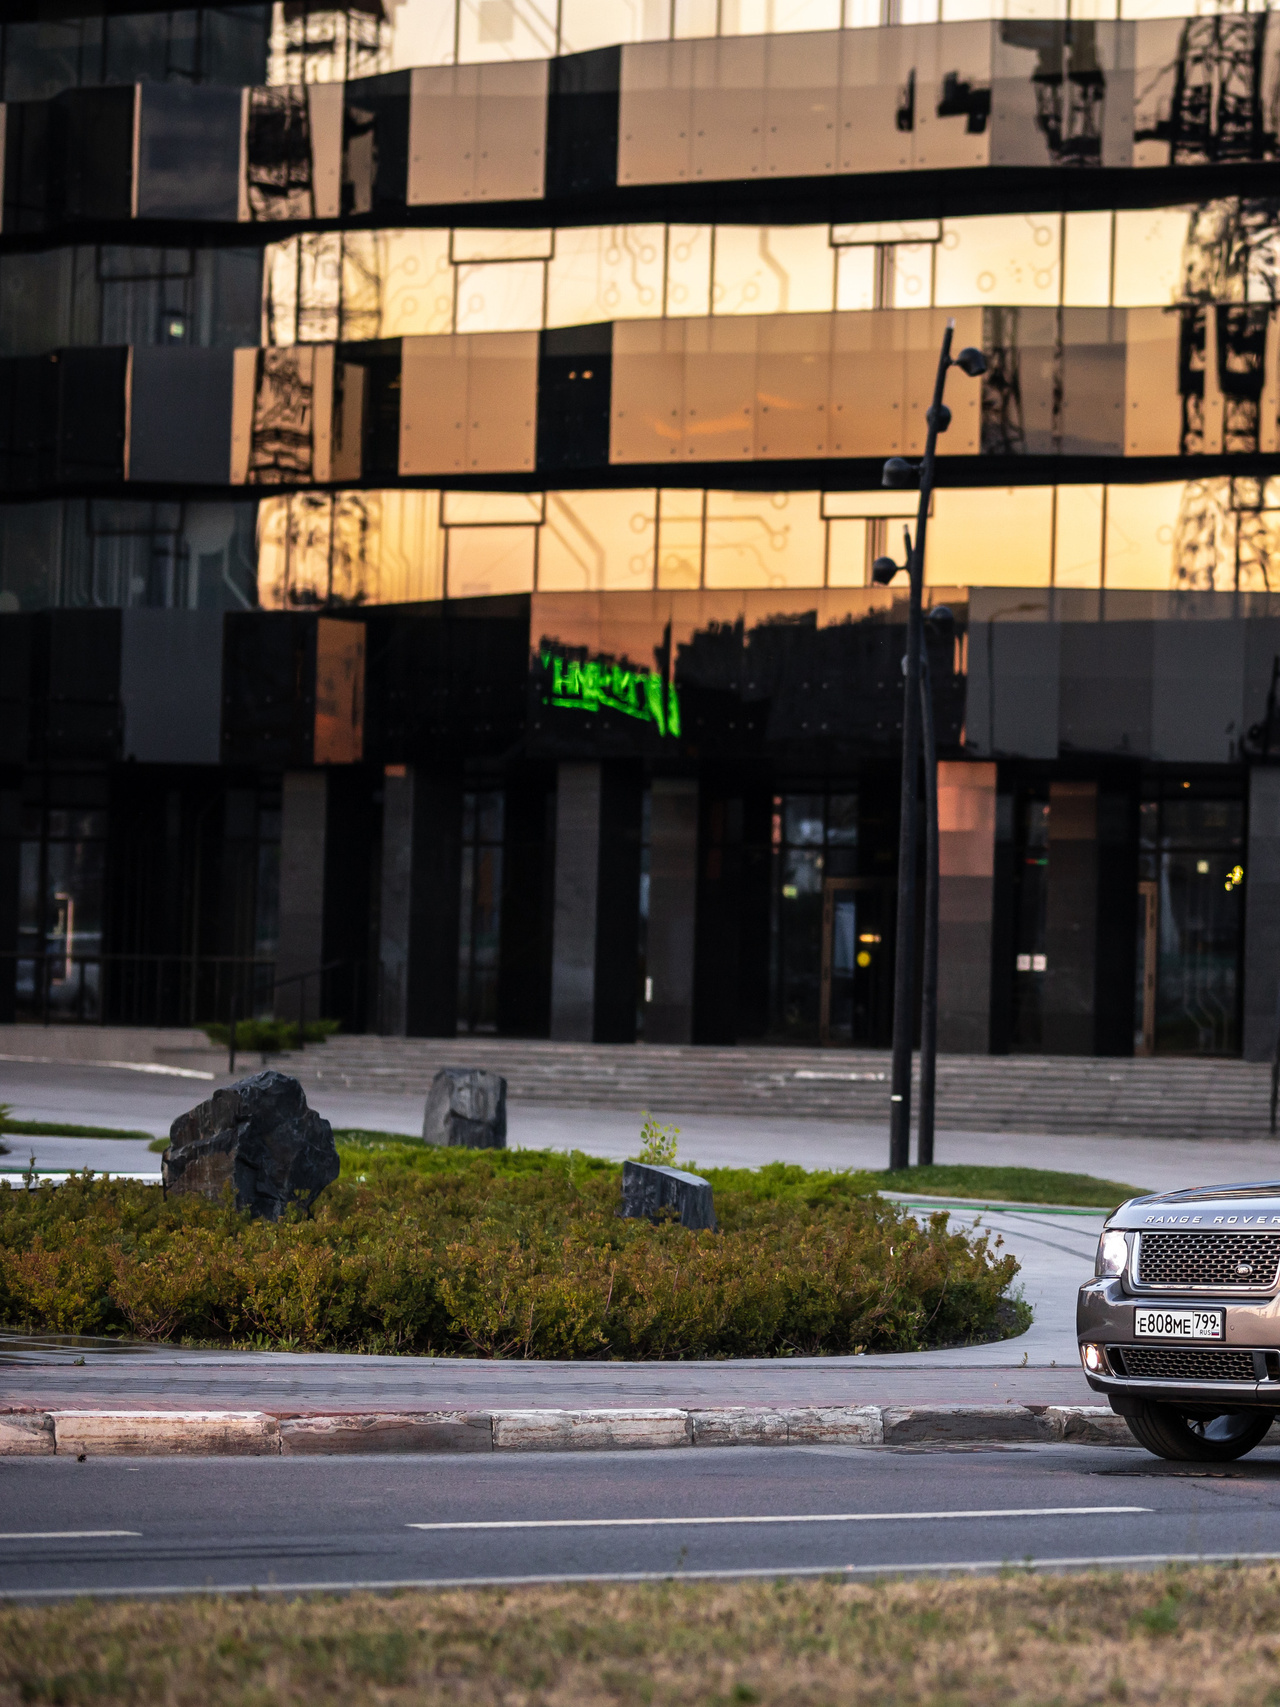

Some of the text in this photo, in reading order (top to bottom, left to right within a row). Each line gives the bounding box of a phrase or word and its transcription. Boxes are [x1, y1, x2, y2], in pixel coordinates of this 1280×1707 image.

[1144, 1215, 1203, 1224] RANGE
[1139, 1313, 1217, 1335] E808ME 799
